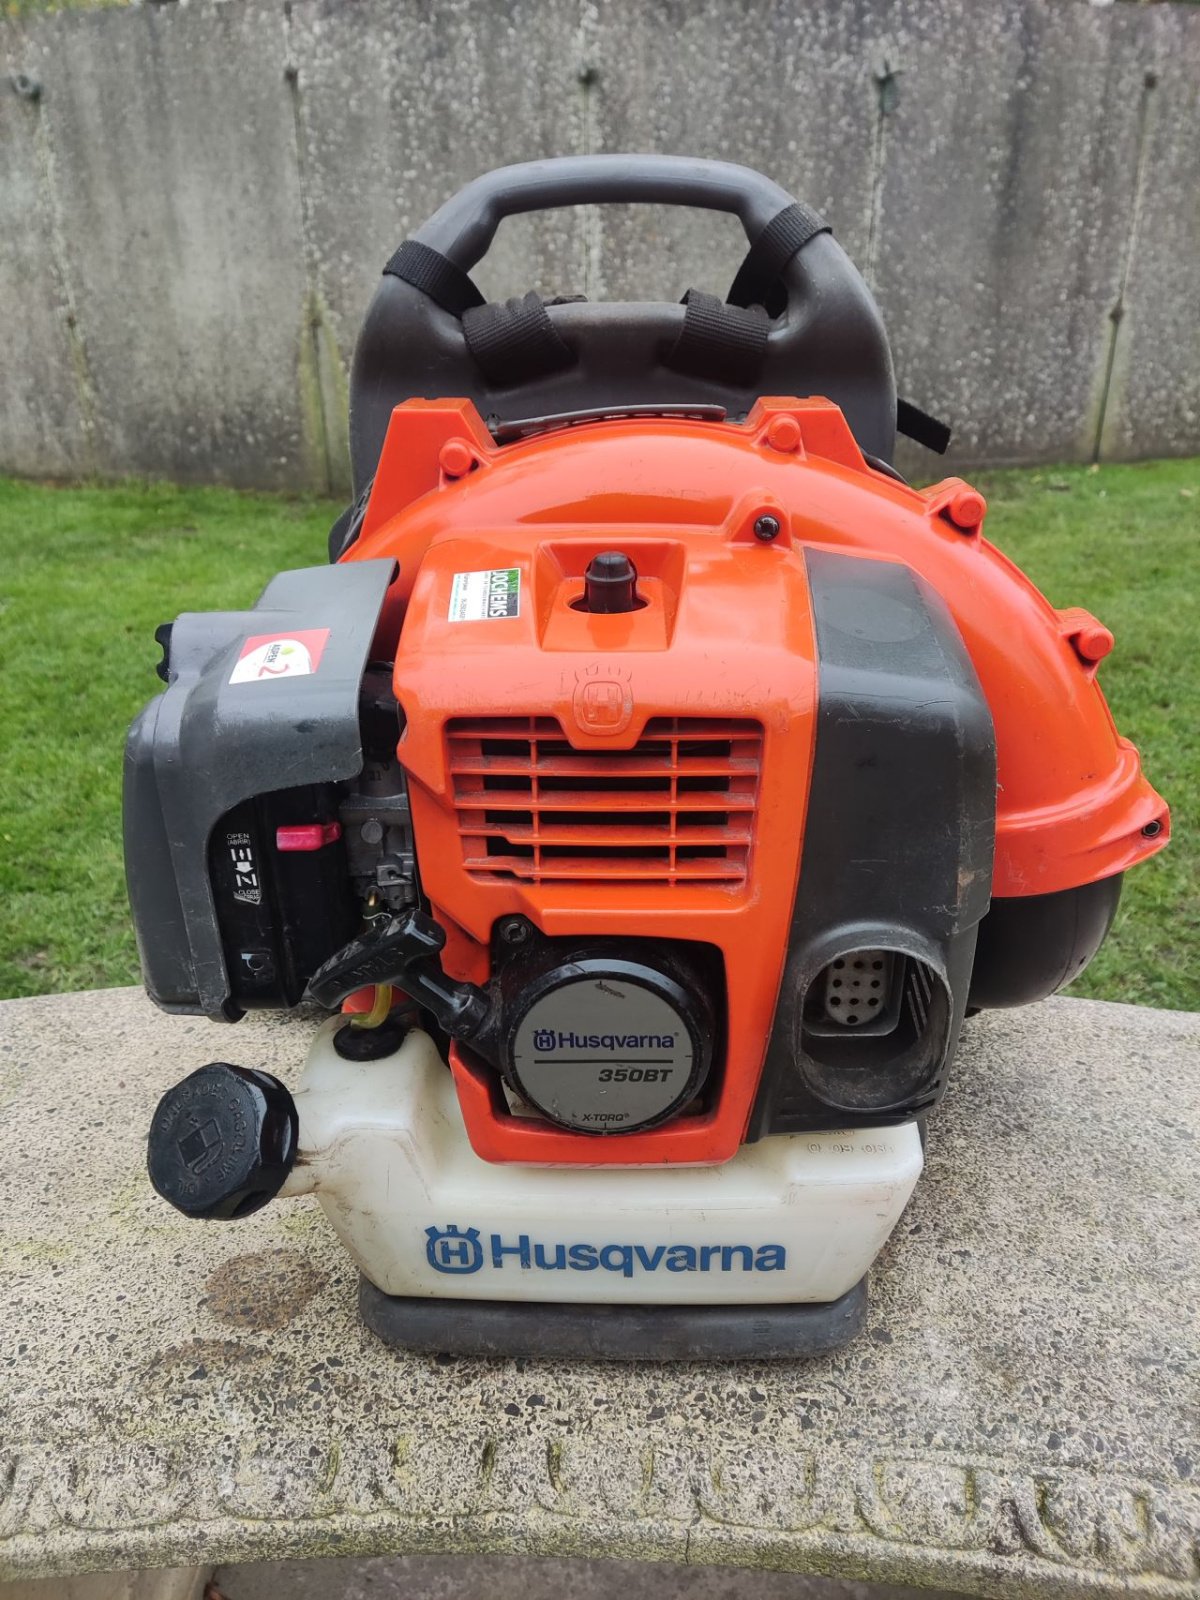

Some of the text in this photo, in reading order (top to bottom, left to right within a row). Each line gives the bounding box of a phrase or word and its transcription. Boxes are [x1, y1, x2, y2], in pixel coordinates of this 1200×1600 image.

[489, 571, 508, 616] JOCHEMS
[559, 1032, 674, 1050] Husqvarna
[598, 1068, 673, 1083] 350BT
[490, 1233, 787, 1278] Husqvarna
